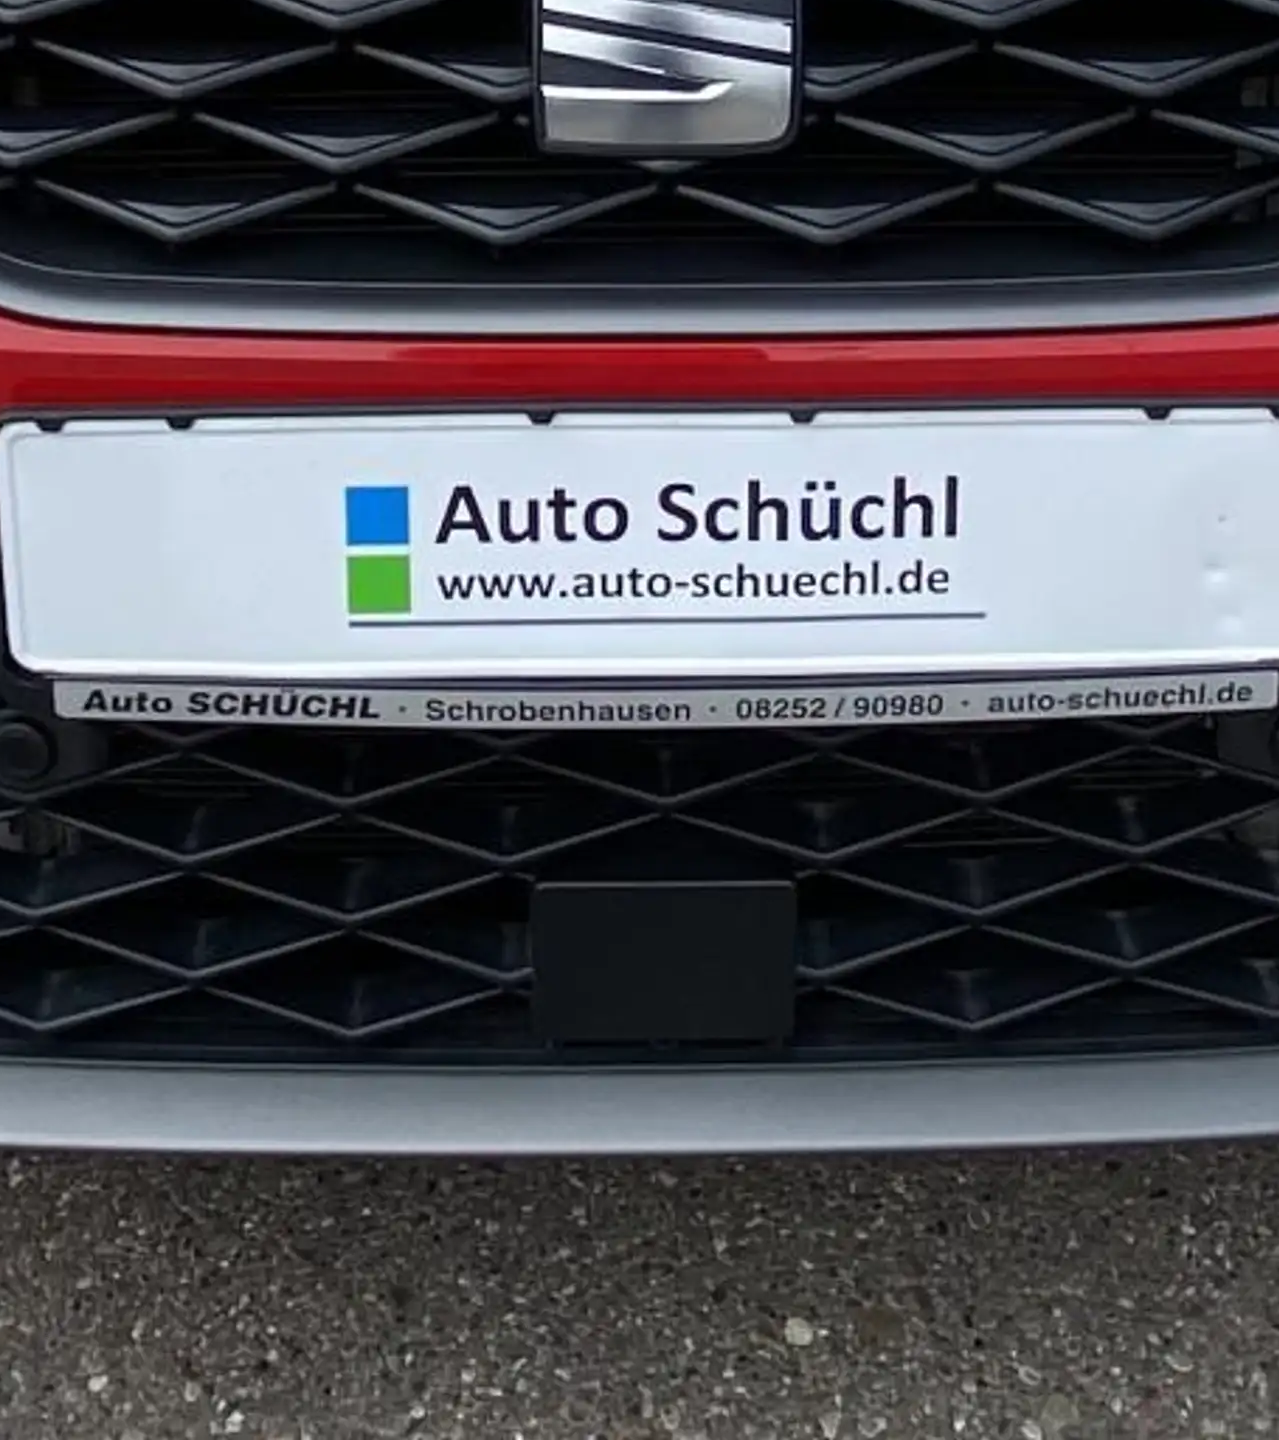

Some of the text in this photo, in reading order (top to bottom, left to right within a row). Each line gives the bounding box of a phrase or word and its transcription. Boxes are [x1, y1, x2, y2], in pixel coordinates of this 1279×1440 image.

[434, 474, 960, 544] Auto Schüchl
[436, 559, 951, 600] www.auto-schuechl.de
[82, 688, 174, 714] Auto
[185, 687, 381, 720] SCHÜCHL
[424, 698, 692, 723] Schrobenhausen
[735, 696, 827, 720] 08252
[852, 693, 944, 717] 90980
[986, 680, 1254, 714] auto-schuechl.de
